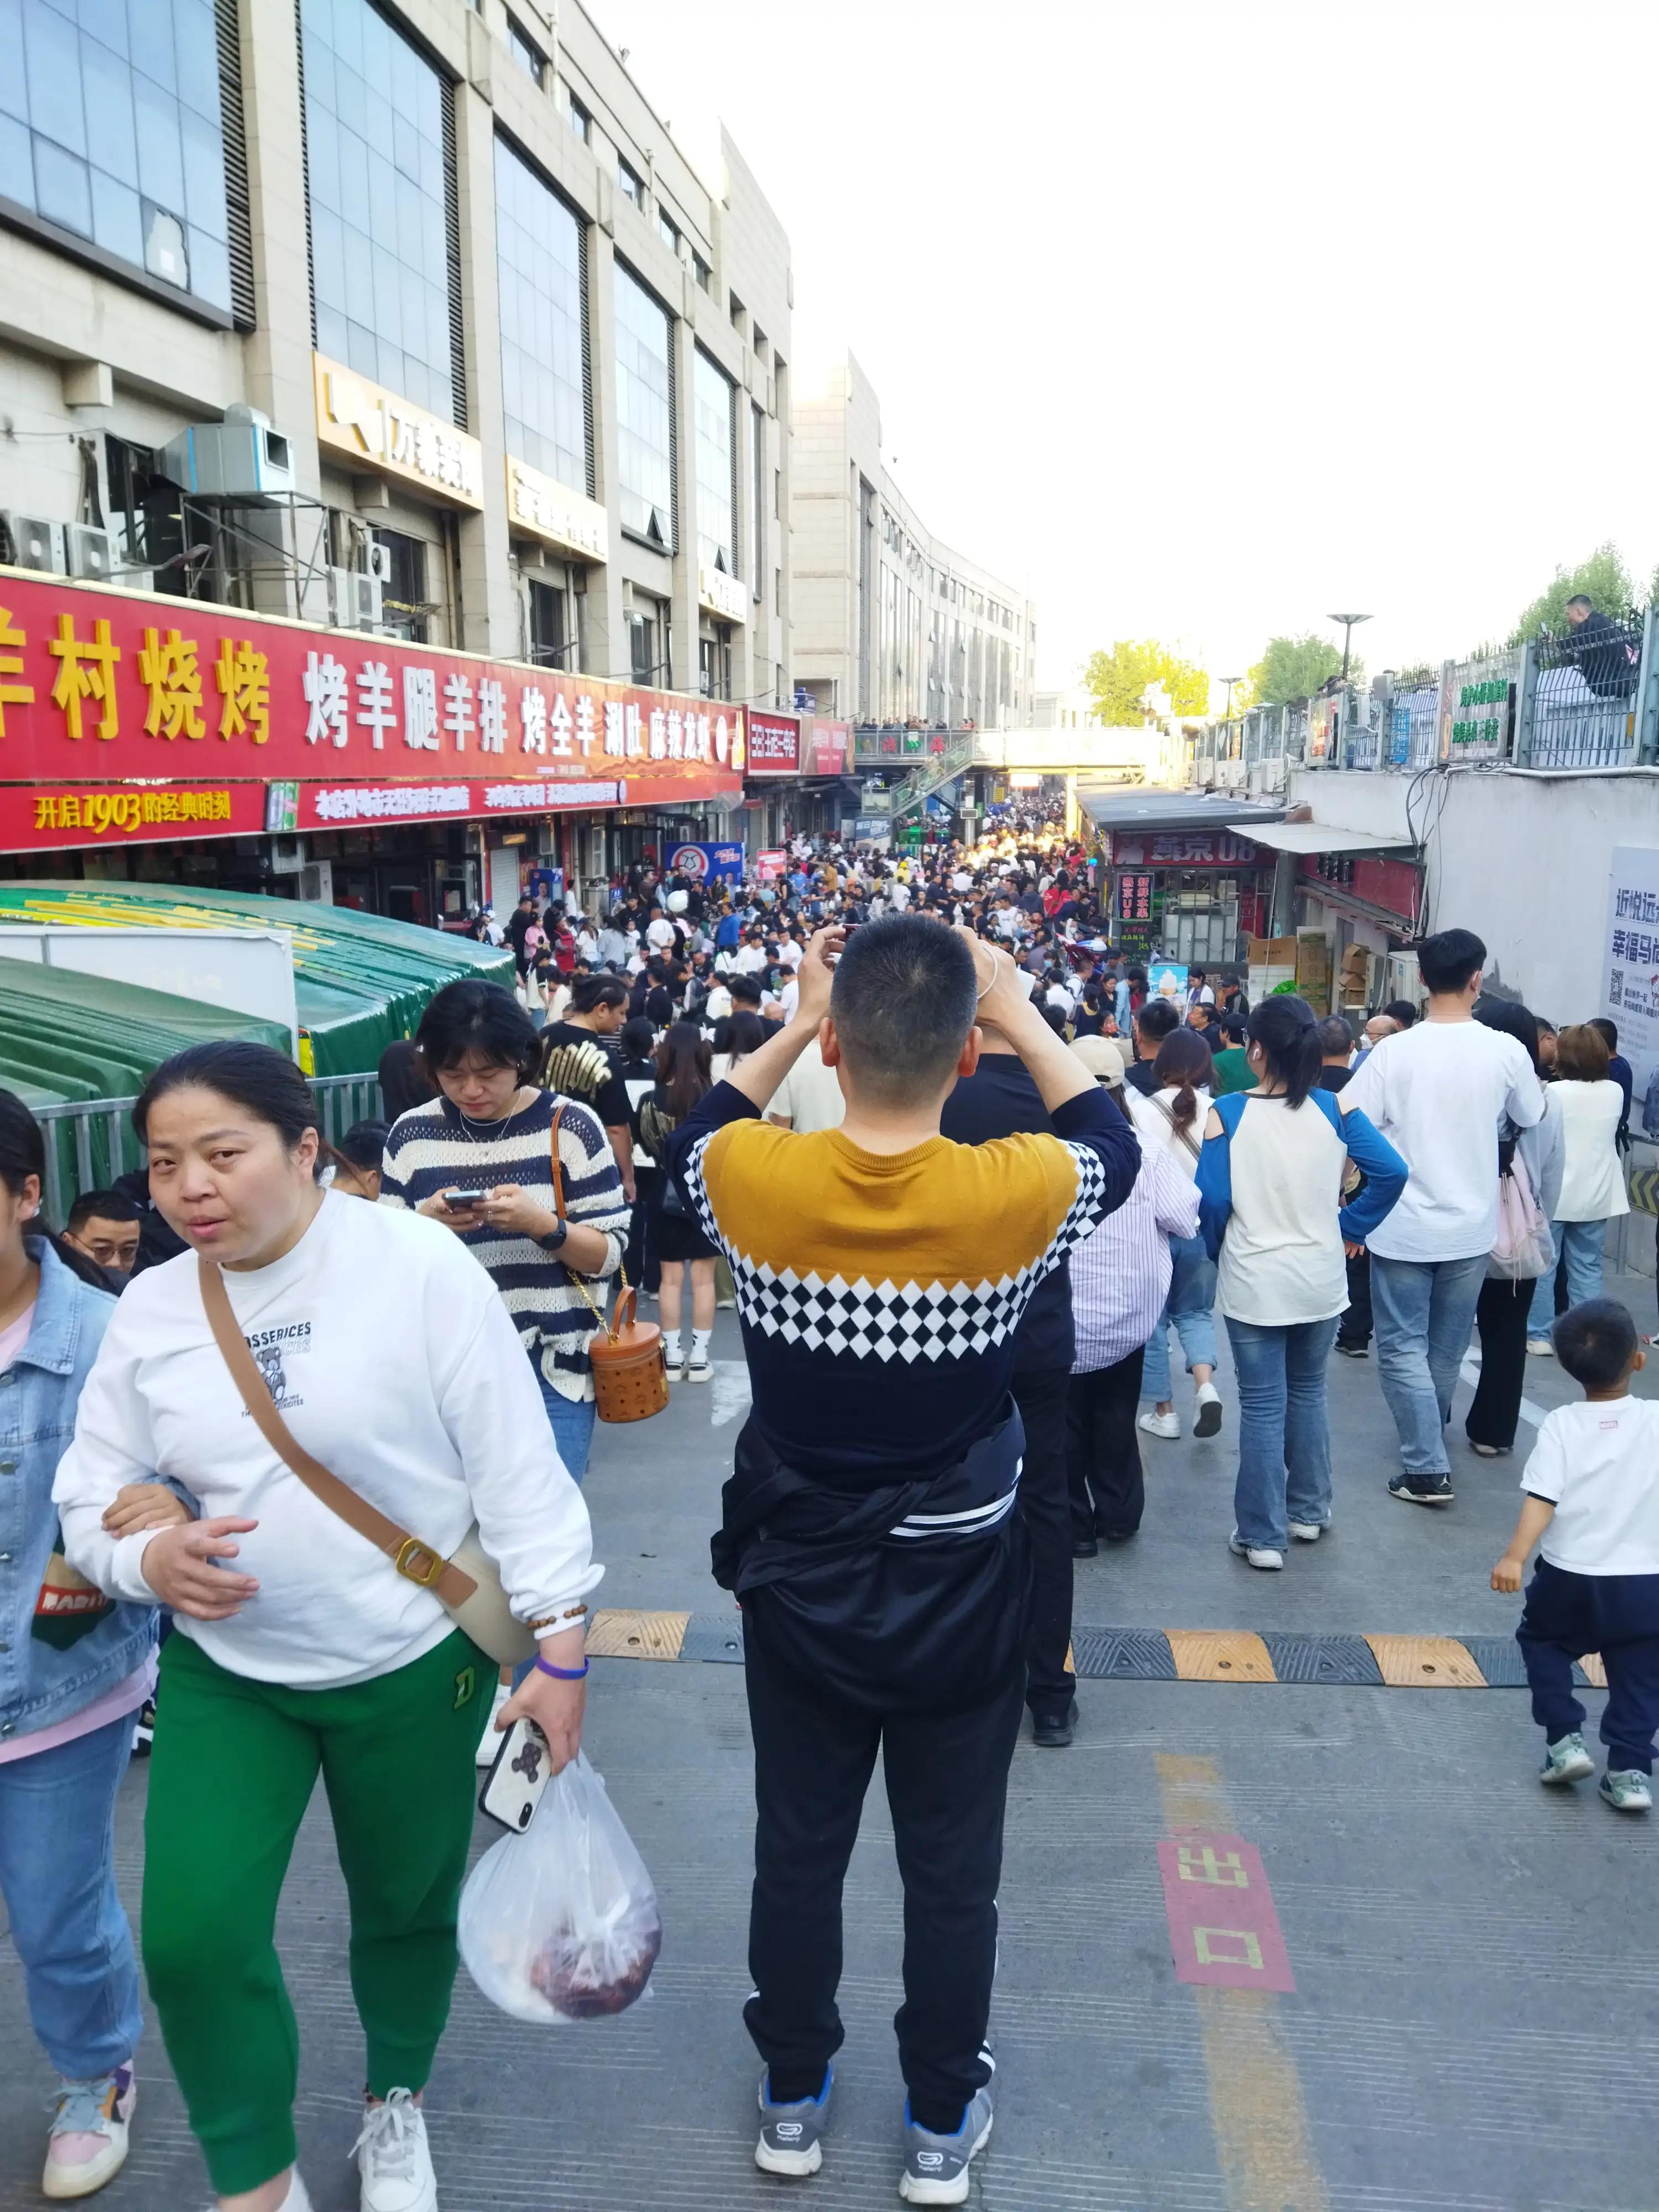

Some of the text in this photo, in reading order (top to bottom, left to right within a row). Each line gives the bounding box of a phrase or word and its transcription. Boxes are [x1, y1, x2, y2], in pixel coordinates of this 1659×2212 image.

[302, 651, 508, 754] 烤羊腿羊排
[521, 686, 596, 757] 烤全羊
[34, 791, 231, 834] 开启1903的经典时刻
[1616, 888, 1659, 924] 近悦远
[1178, 1846, 1264, 1970] 出口
